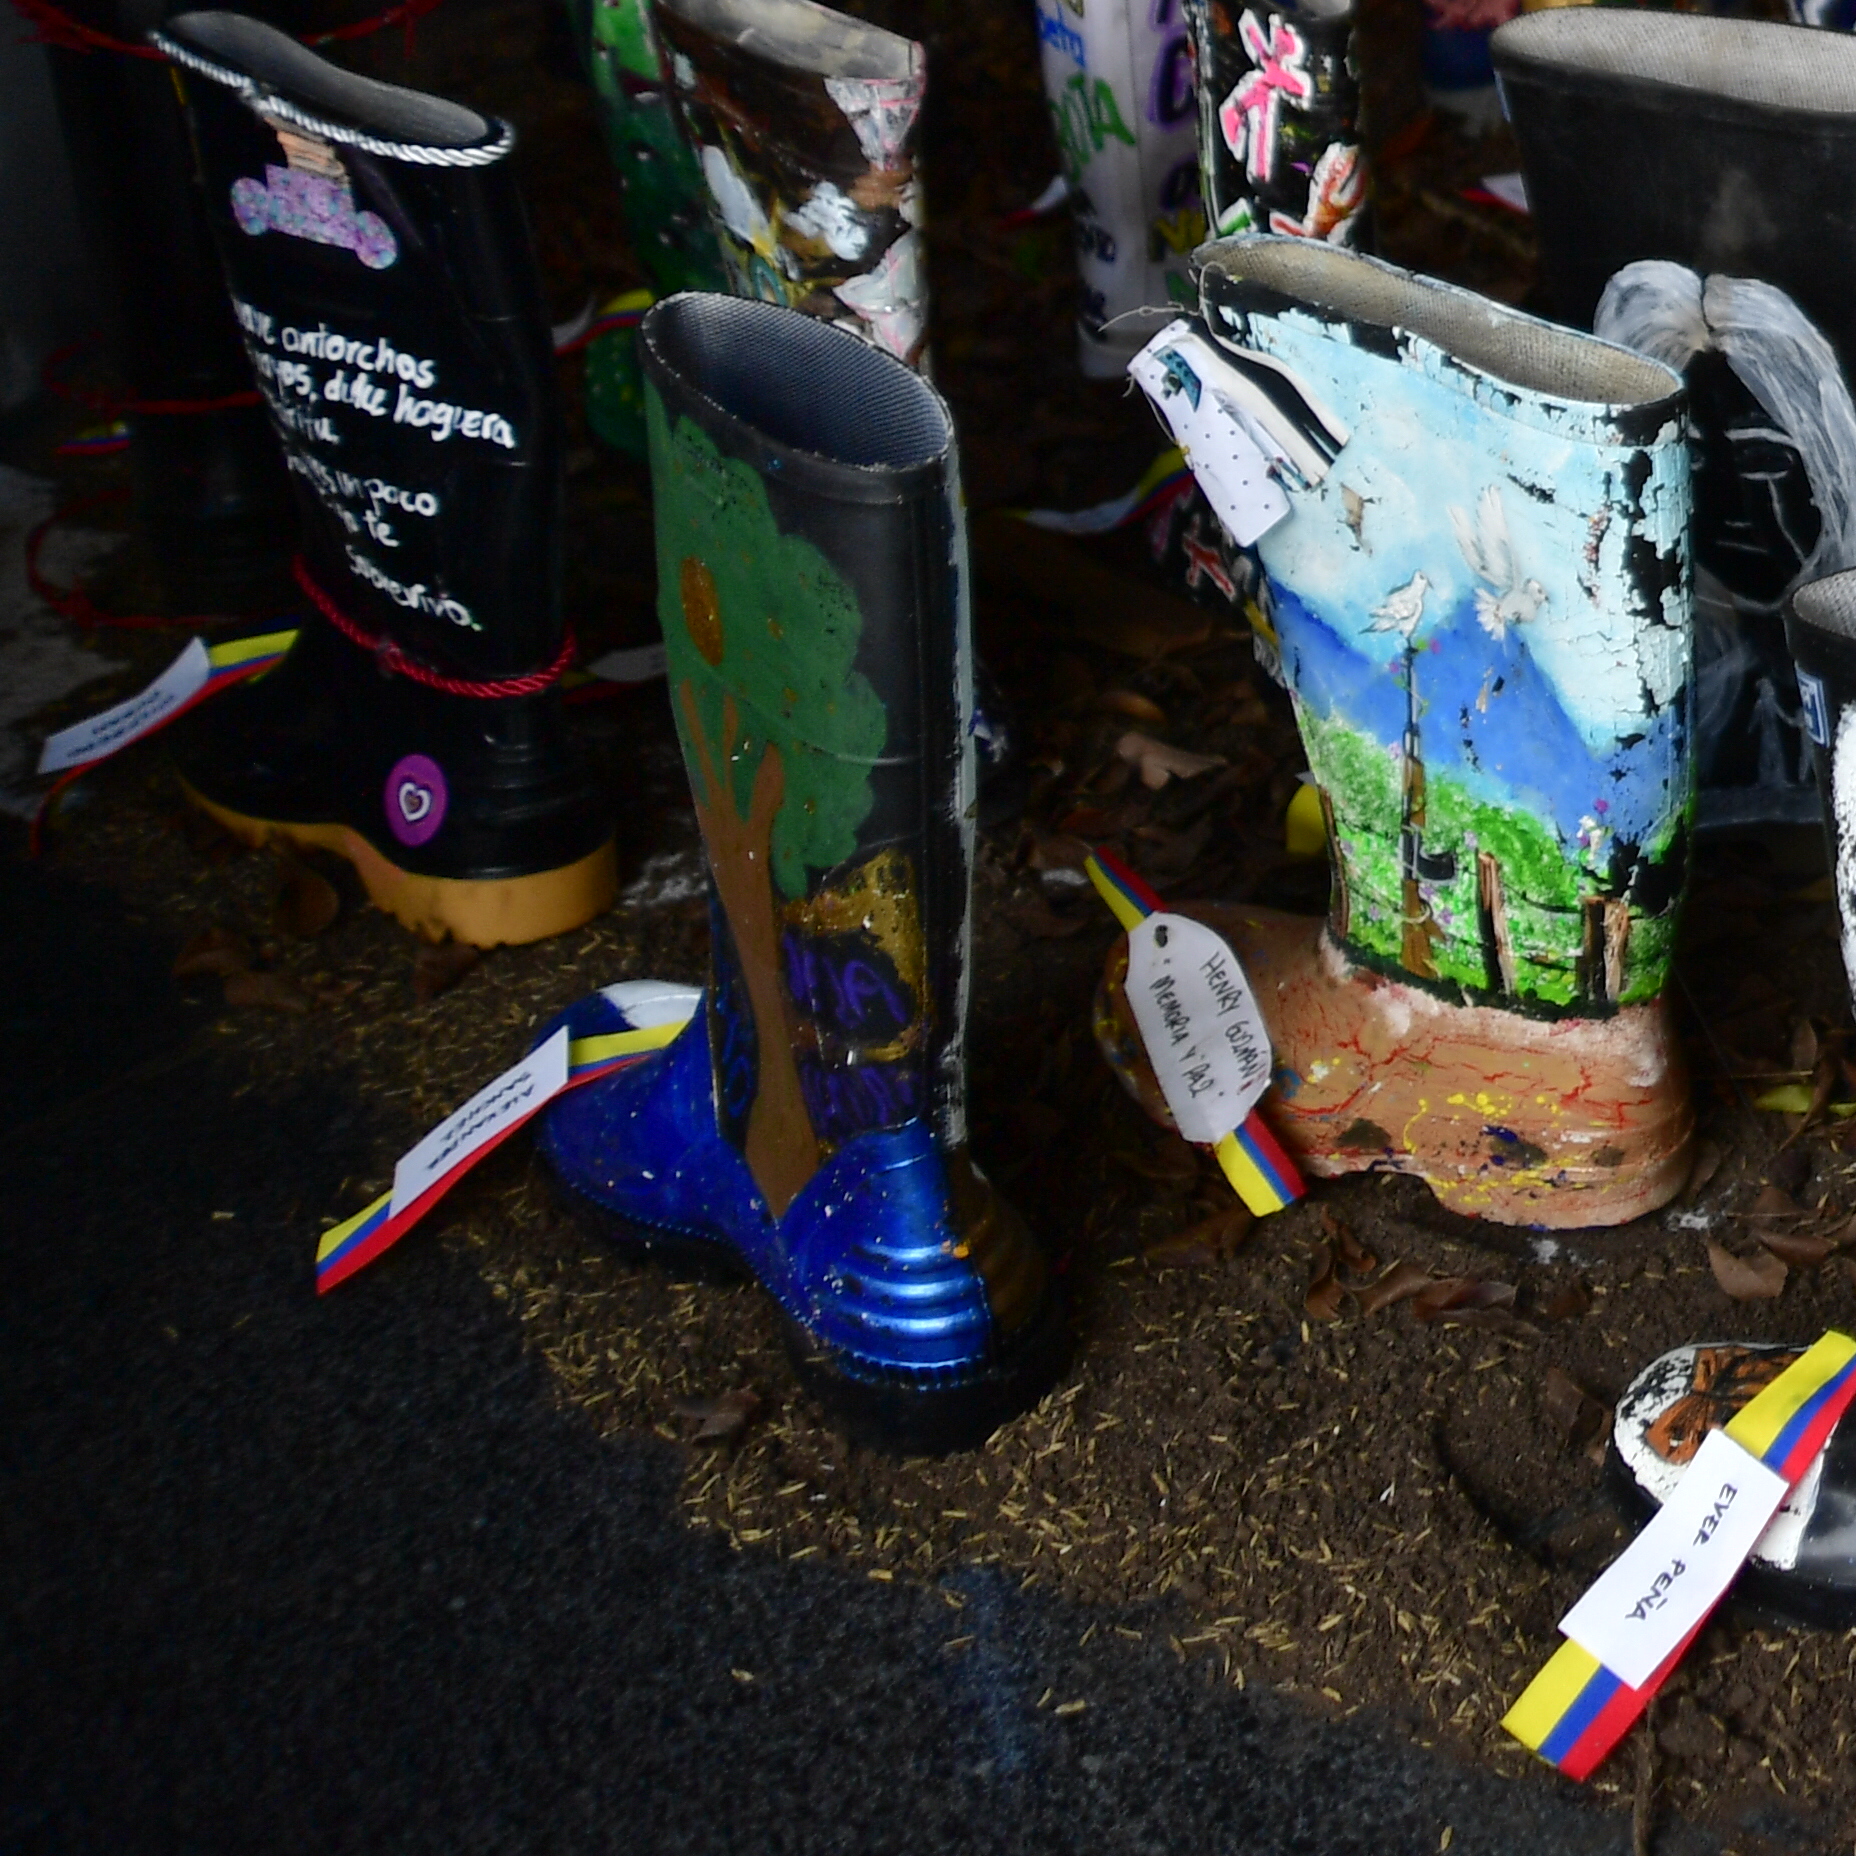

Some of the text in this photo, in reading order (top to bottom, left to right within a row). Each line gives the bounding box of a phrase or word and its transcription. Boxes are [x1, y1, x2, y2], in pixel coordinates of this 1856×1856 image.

[393, 384, 516, 449] hoguera
[365, 479, 441, 517] poco
[1199, 951, 1243, 1016] HENRY
[1625, 1483, 1738, 1621] EVER PEÑA
